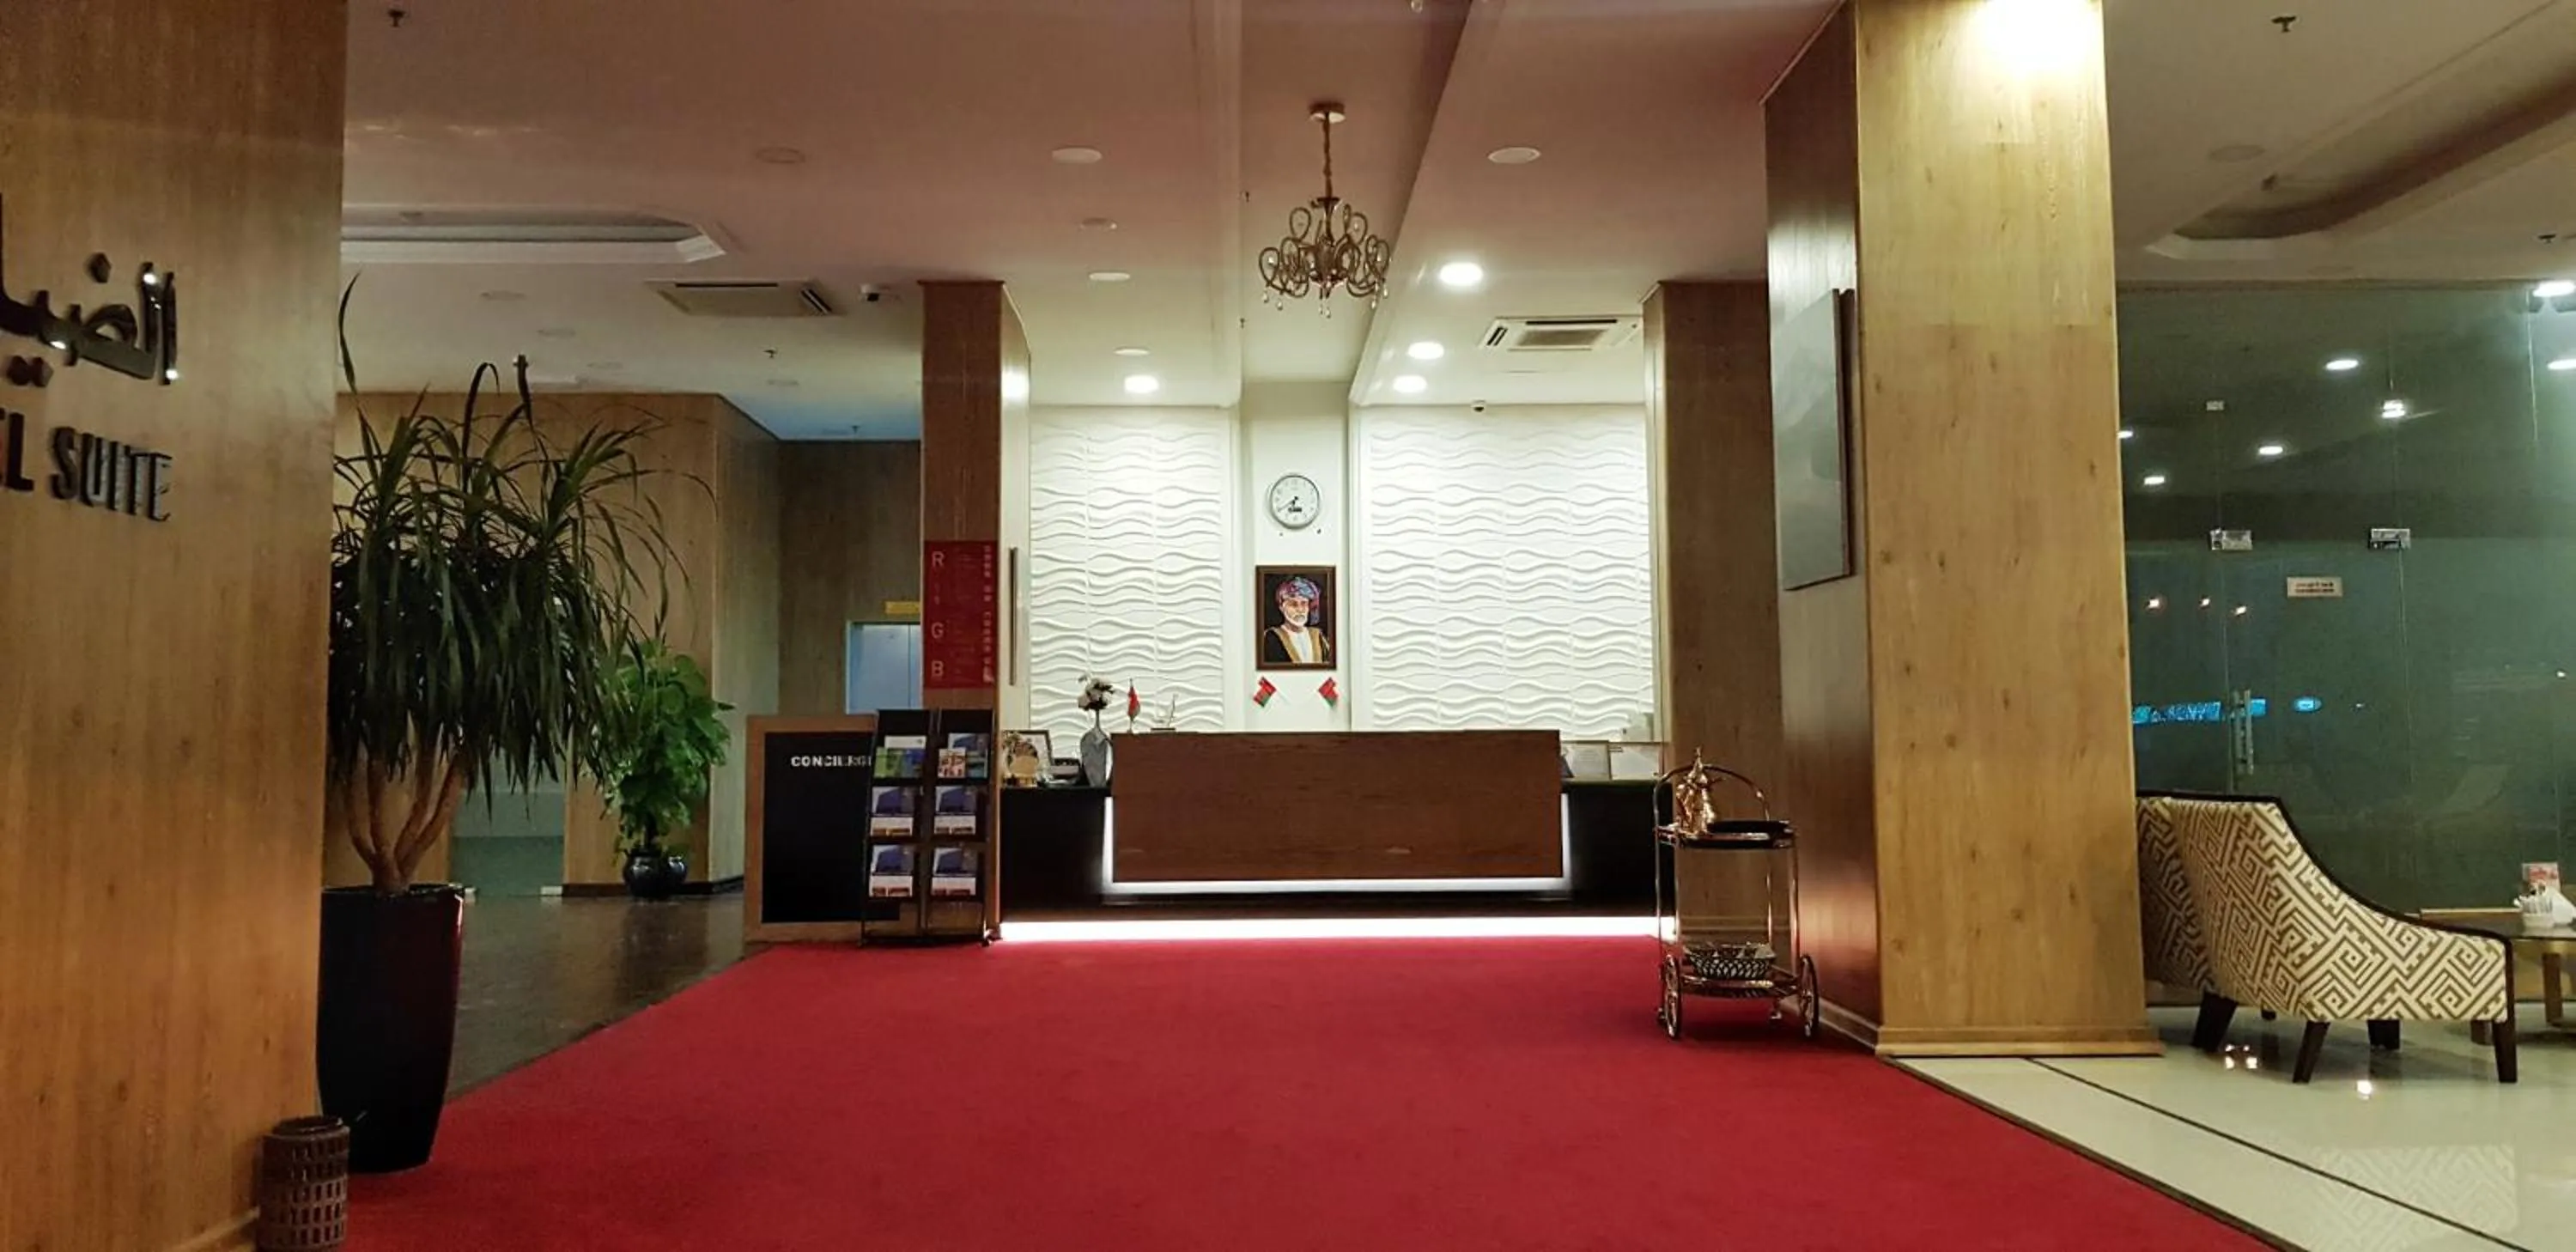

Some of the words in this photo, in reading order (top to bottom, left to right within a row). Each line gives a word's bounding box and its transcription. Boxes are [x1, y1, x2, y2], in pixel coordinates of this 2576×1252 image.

[50, 426, 173, 522] SUITE
[932, 551, 944, 567] R
[932, 623, 944, 638] G
[932, 660, 944, 678] B
